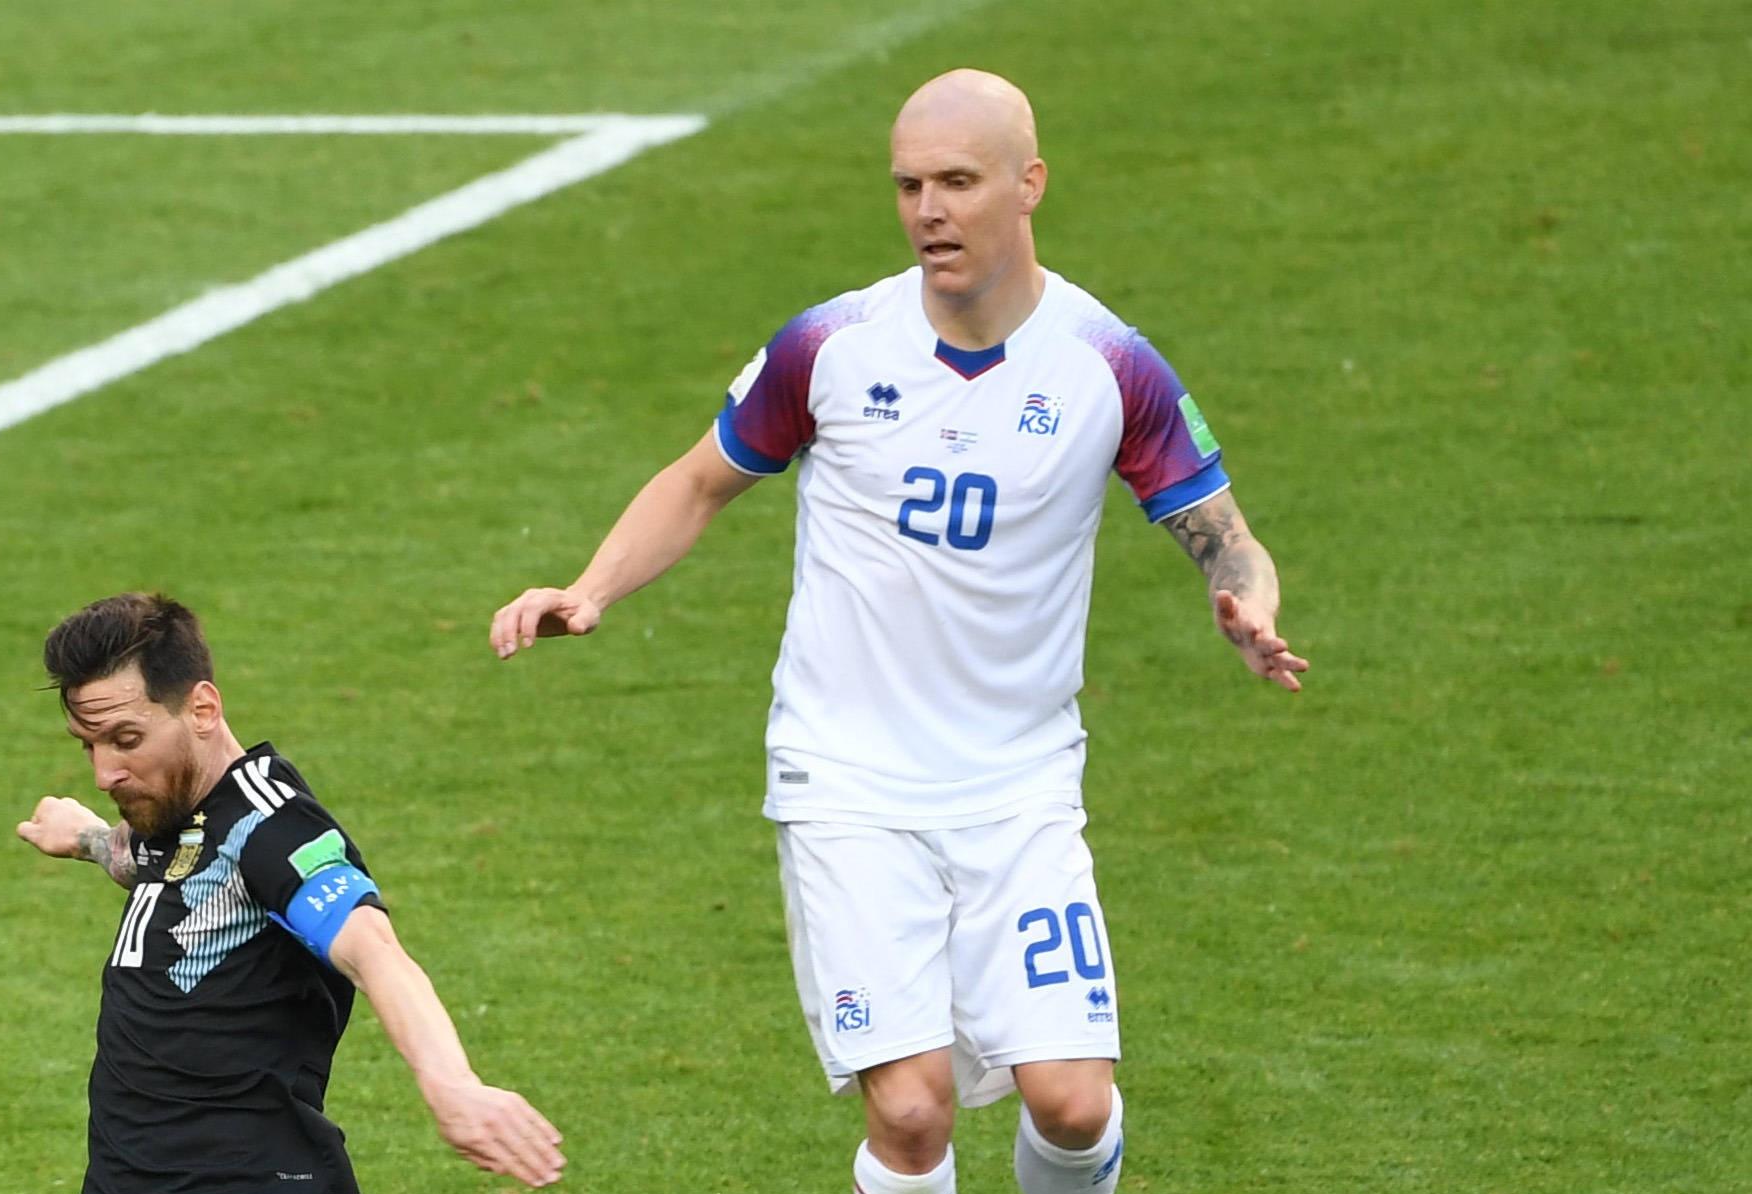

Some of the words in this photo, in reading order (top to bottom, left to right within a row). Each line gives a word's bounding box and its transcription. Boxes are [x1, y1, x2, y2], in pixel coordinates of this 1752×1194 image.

[898, 466, 997, 551] 20
[111, 883, 165, 968] 10
[1018, 902, 1106, 989] 20
